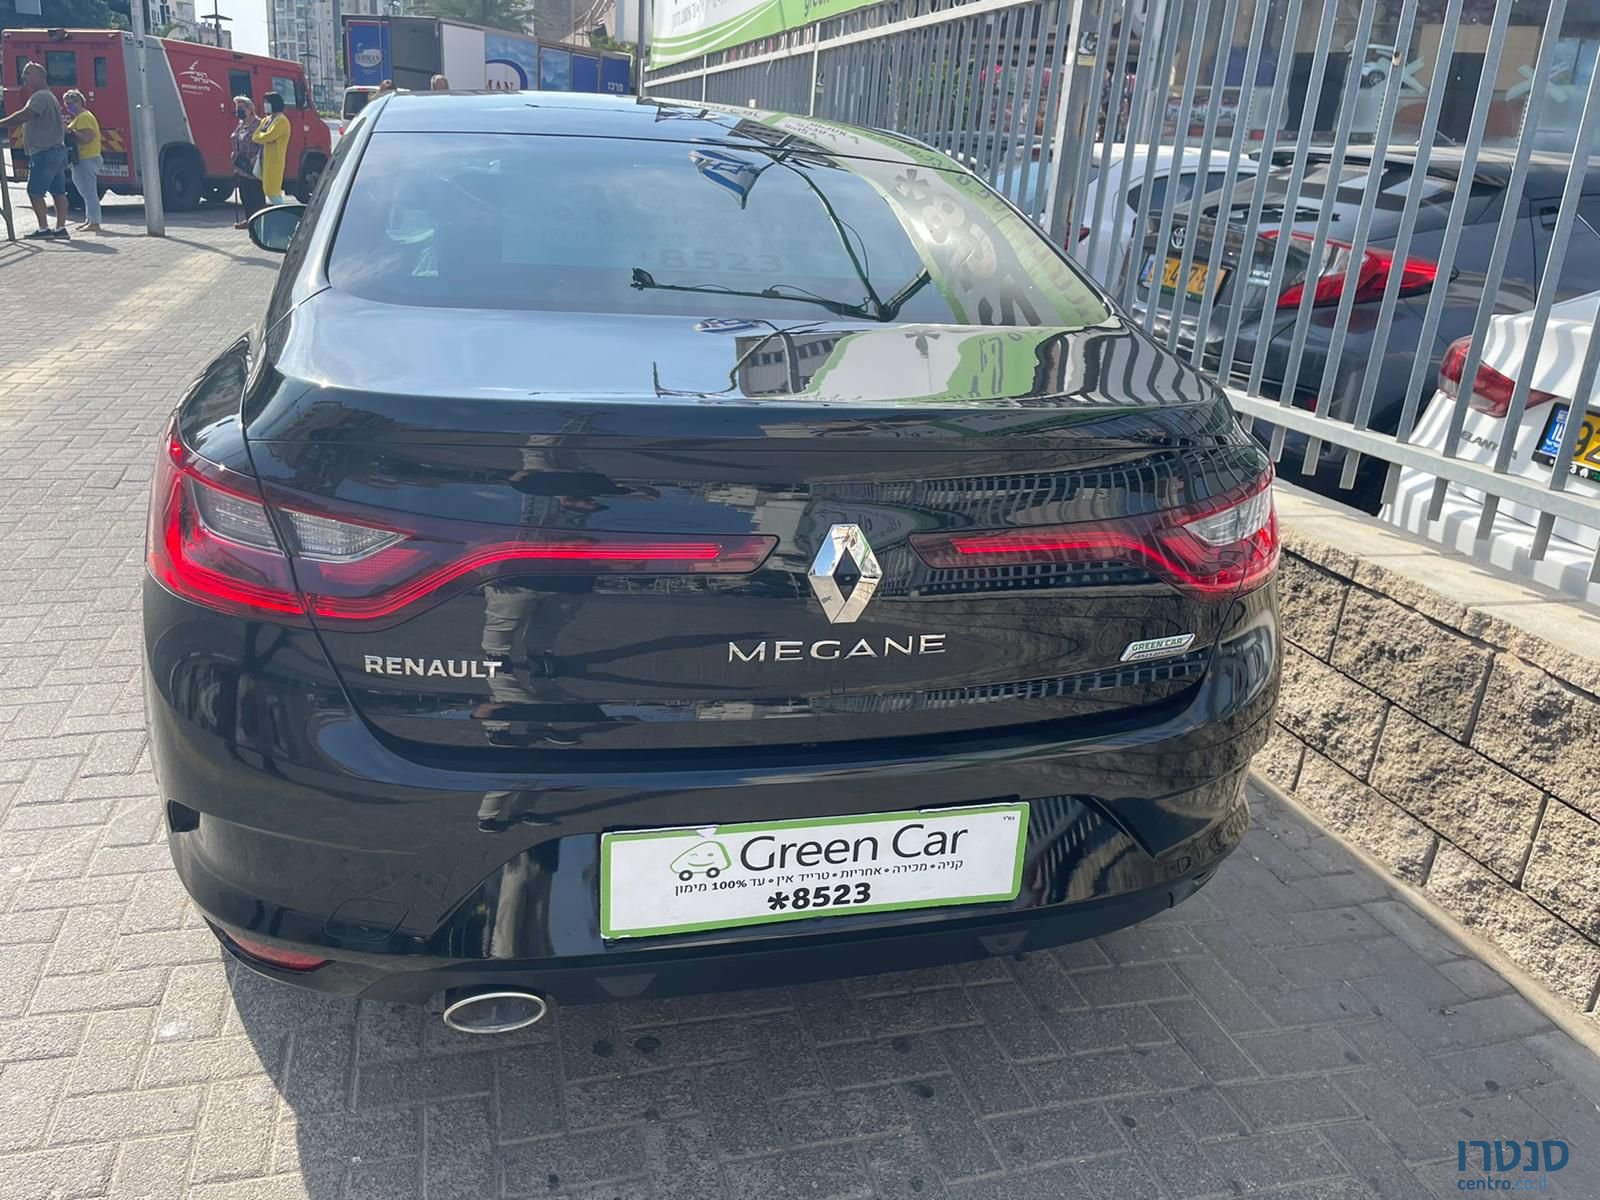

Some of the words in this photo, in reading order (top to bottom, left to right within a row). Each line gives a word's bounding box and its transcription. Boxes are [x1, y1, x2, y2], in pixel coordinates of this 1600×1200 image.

[728, 634, 946, 662] MEGANE
[1132, 640, 1163, 651] GREEN
[1165, 638, 1183, 646] CAR
[364, 655, 502, 678] RENAULT
[740, 835, 878, 871] Green
[892, 823, 968, 858] Car
[892, 863, 927, 874] מכירה
[937, 860, 964, 870] קניה
[799, 871, 830, 882] טרייד
[840, 866, 882, 878] אחריות
[712, 879, 747, 891] 100%
[750, 878, 765, 887] עד
[777, 875, 794, 886] אין
[675, 882, 707, 896] מימון
